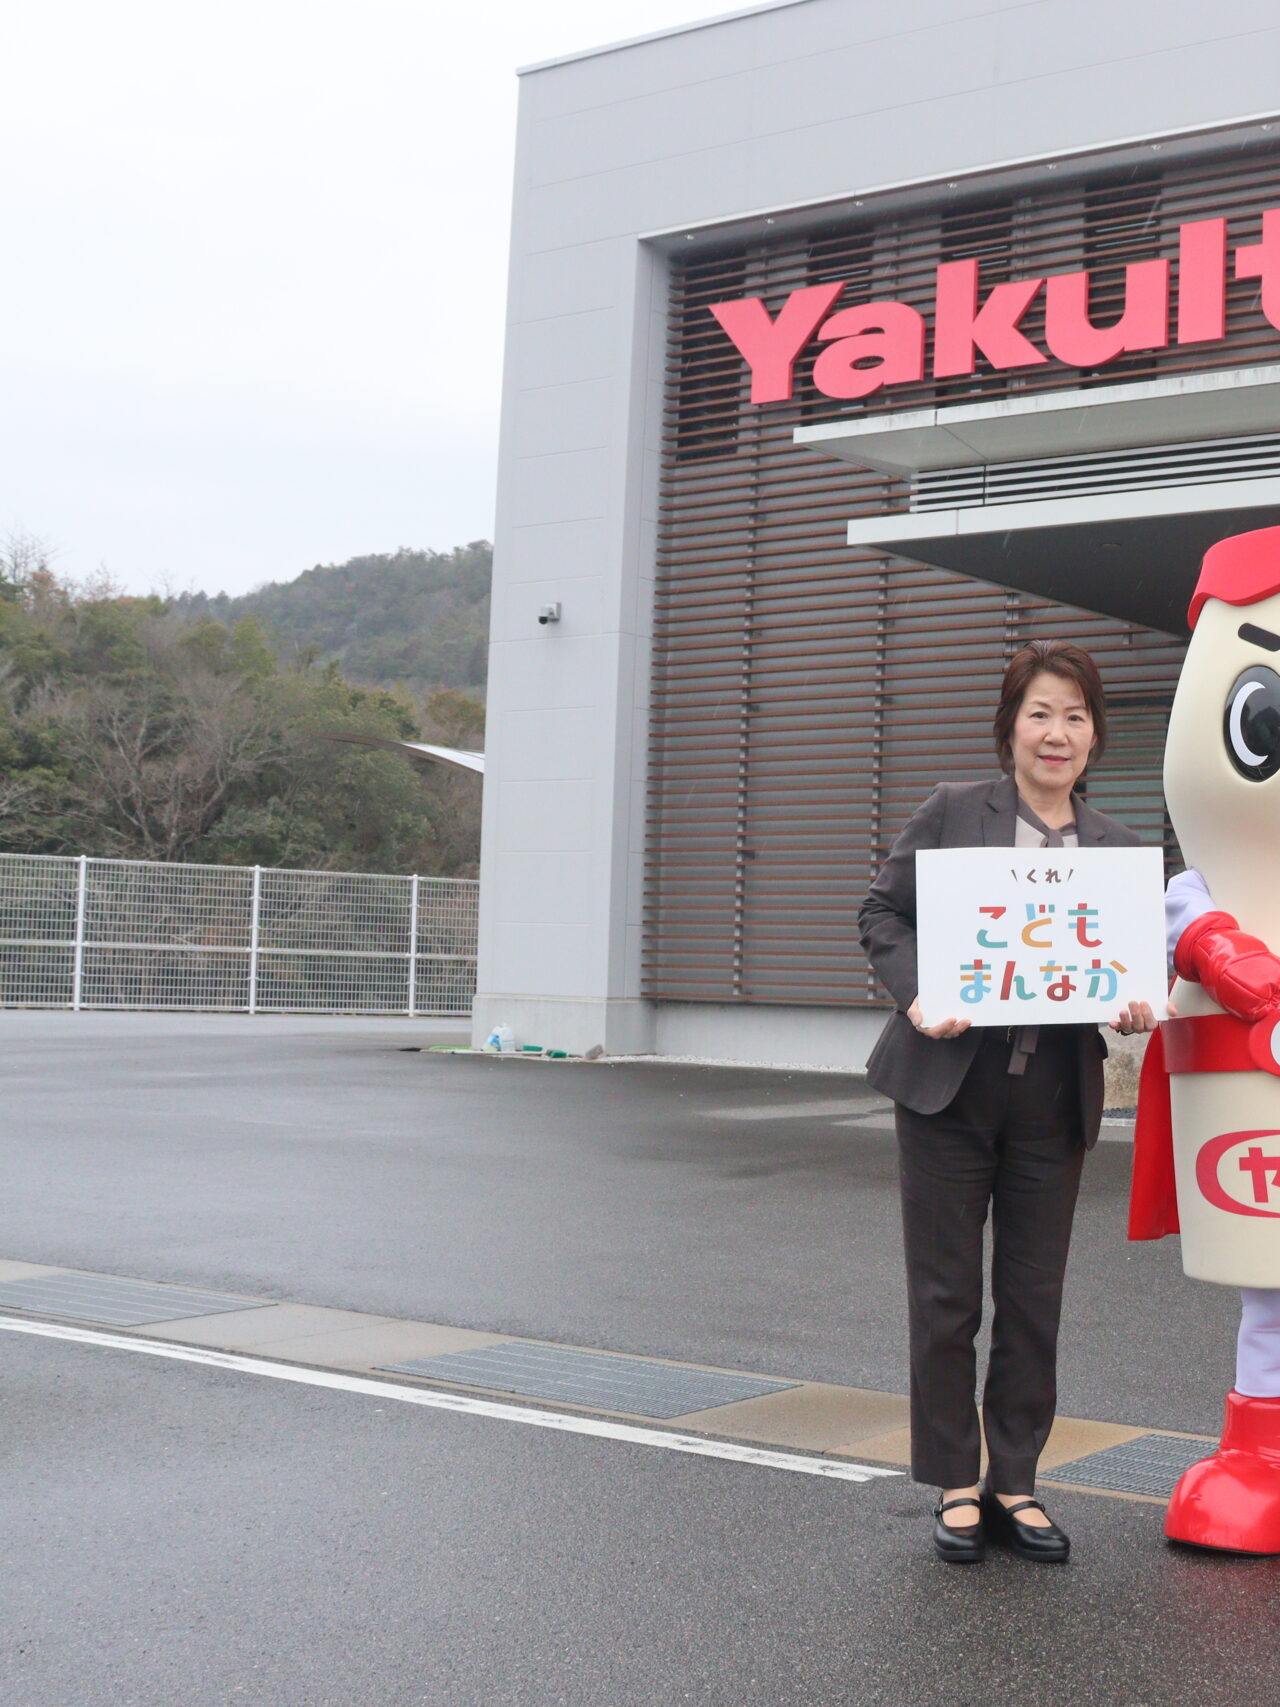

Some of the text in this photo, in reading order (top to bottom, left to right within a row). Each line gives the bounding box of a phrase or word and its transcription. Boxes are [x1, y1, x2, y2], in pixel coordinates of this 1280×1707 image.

[1026, 868, 1062, 884] くれ
[976, 903, 1103, 948] こども
[960, 959, 1128, 1004] まんなか
